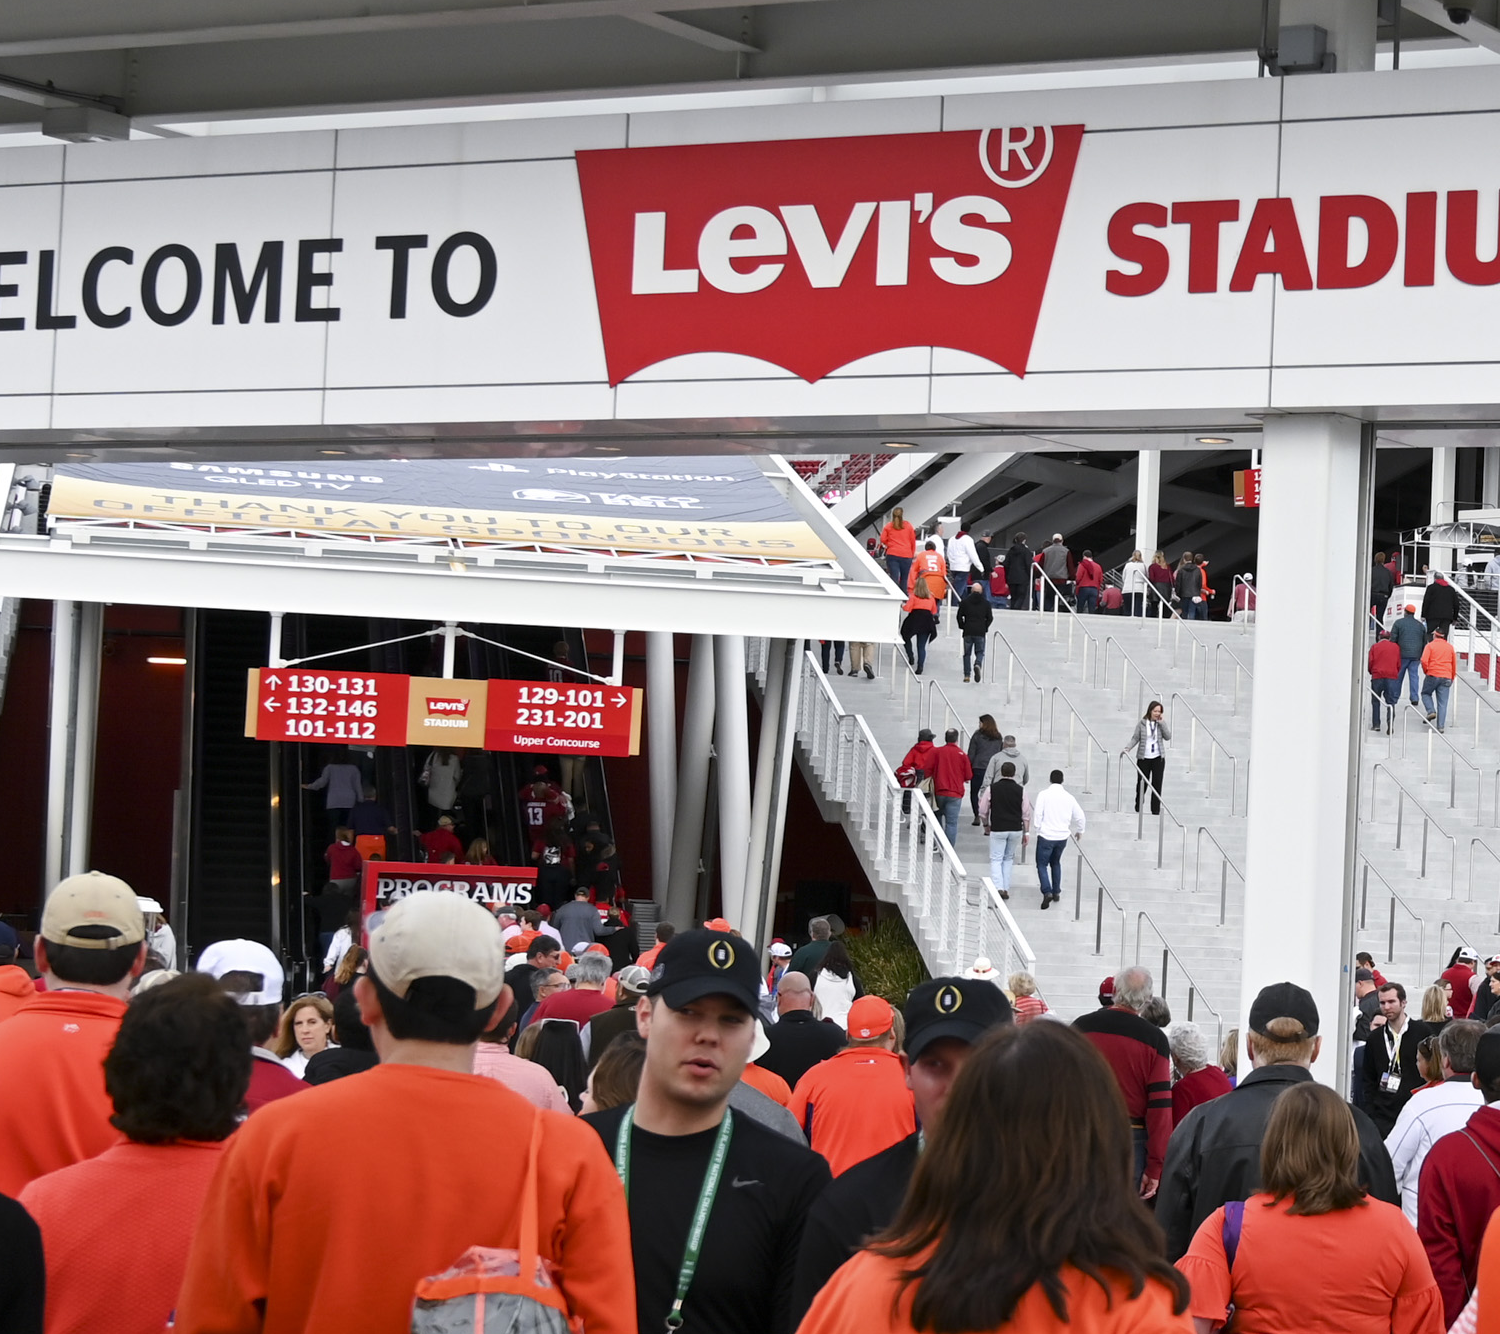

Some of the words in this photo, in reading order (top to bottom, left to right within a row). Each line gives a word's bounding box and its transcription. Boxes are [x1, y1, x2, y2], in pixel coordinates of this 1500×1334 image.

[375, 230, 498, 320] TO
[169, 462, 384, 484] SAMSUNG
[204, 475, 301, 488] QLED
[310, 483, 352, 491] TV
[590, 491, 702, 505] TACO
[600, 499, 703, 509] BELL
[93, 498, 422, 532] OFFICIAL
[442, 524, 797, 550] SPONSORS
[151, 494, 357, 516] THANK
[380, 509, 496, 526] YOU
[515, 518, 594, 531] TO
[615, 523, 735, 537] OUR
[927, 559, 938, 572] 5
[287, 674, 378, 696] 130-131
[286, 696, 378, 718] 132-146
[518, 686, 605, 708] 129-101
[285, 718, 376, 740] 101-112
[423, 717, 469, 729] STADIUM
[516, 708, 604, 729] 231-201
[513, 735, 545, 749] Upper
[546, 736, 601, 749] Concourse
[527, 807, 544, 826] 13
[376, 878, 534, 906] PROGRAMS
